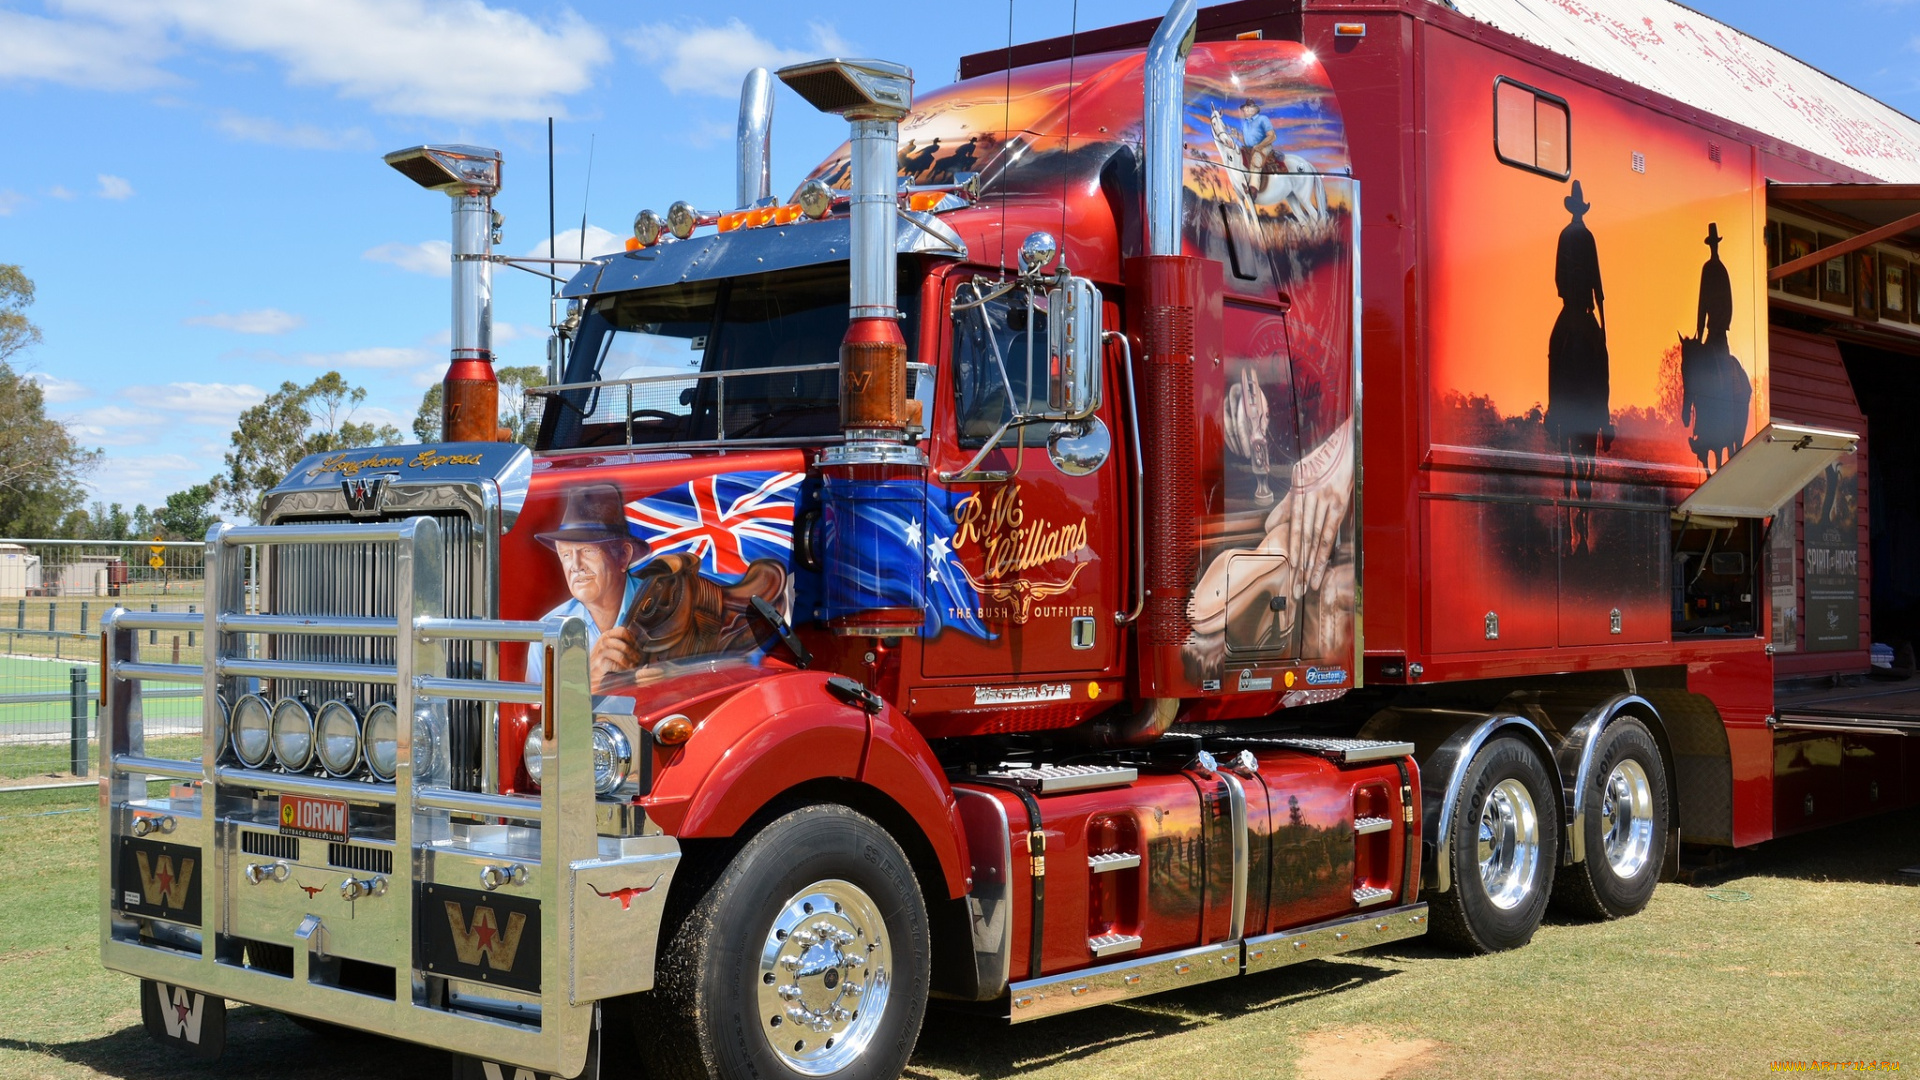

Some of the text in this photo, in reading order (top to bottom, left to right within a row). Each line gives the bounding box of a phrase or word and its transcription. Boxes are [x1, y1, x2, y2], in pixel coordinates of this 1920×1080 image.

[307, 449, 484, 477] Longhorn Express
[984, 516, 1088, 580] Williams
[1807, 548, 1830, 575] SPIRIT
[948, 605, 1095, 620] THE BUSH OUTFITTER
[1040, 683, 1072, 699] STAR
[280, 828, 344, 843] OUTBACK QUEENSLAND
